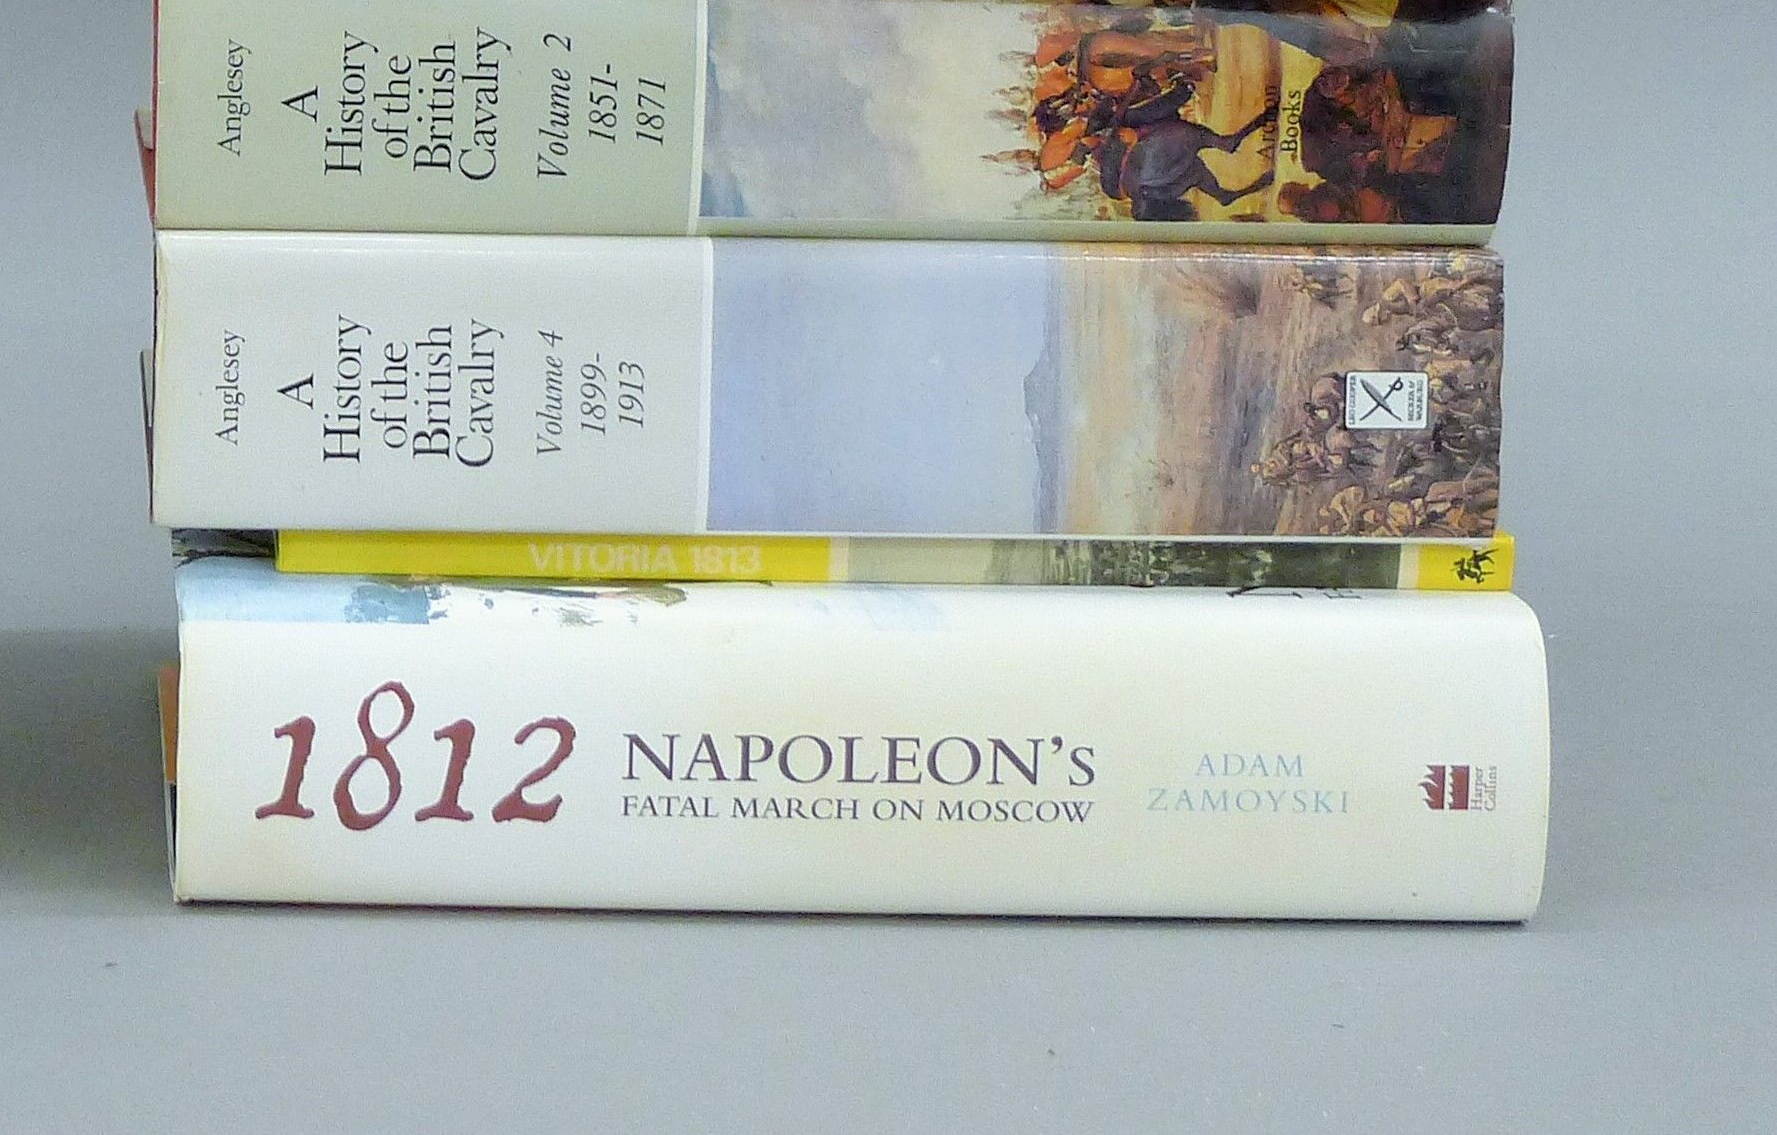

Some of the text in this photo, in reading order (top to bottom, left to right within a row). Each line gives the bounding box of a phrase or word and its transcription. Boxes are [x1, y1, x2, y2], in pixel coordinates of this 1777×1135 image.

[217, 38, 254, 157] Anglesey
[280, 85, 320, 123] A
[324, 30, 379, 176] History
[371, 54, 413, 160] of the
[413, 40, 458, 173] British
[458, 26, 512, 182] Cavalry
[536, 32, 573, 181] Volume 2
[588, 64, 619, 145] 1851-
[635, 77, 668, 147] 1871
[1280, 90, 1302, 153] Books
[215, 329, 247, 446] Anglesey
[276, 373, 315, 410] A
[322, 314, 373, 464] History
[370, 342, 409, 450] of the
[412, 324, 453, 460] British
[455, 318, 505, 468] Cavalry
[536, 329, 564, 456] Volume 4
[580, 353, 608, 436] 1899-
[618, 361, 646, 429] 1913
[526, 541, 762, 575] VITORIA 1813
[254, 679, 579, 832] 1812
[622, 731, 1097, 788] NAPOLEON'S
[1146, 787, 1351, 816] ZAMOYSKI
[1194, 753, 1305, 779] ADAM
[621, 794, 1094, 824] FATAL MARCH ON MOSCOW
